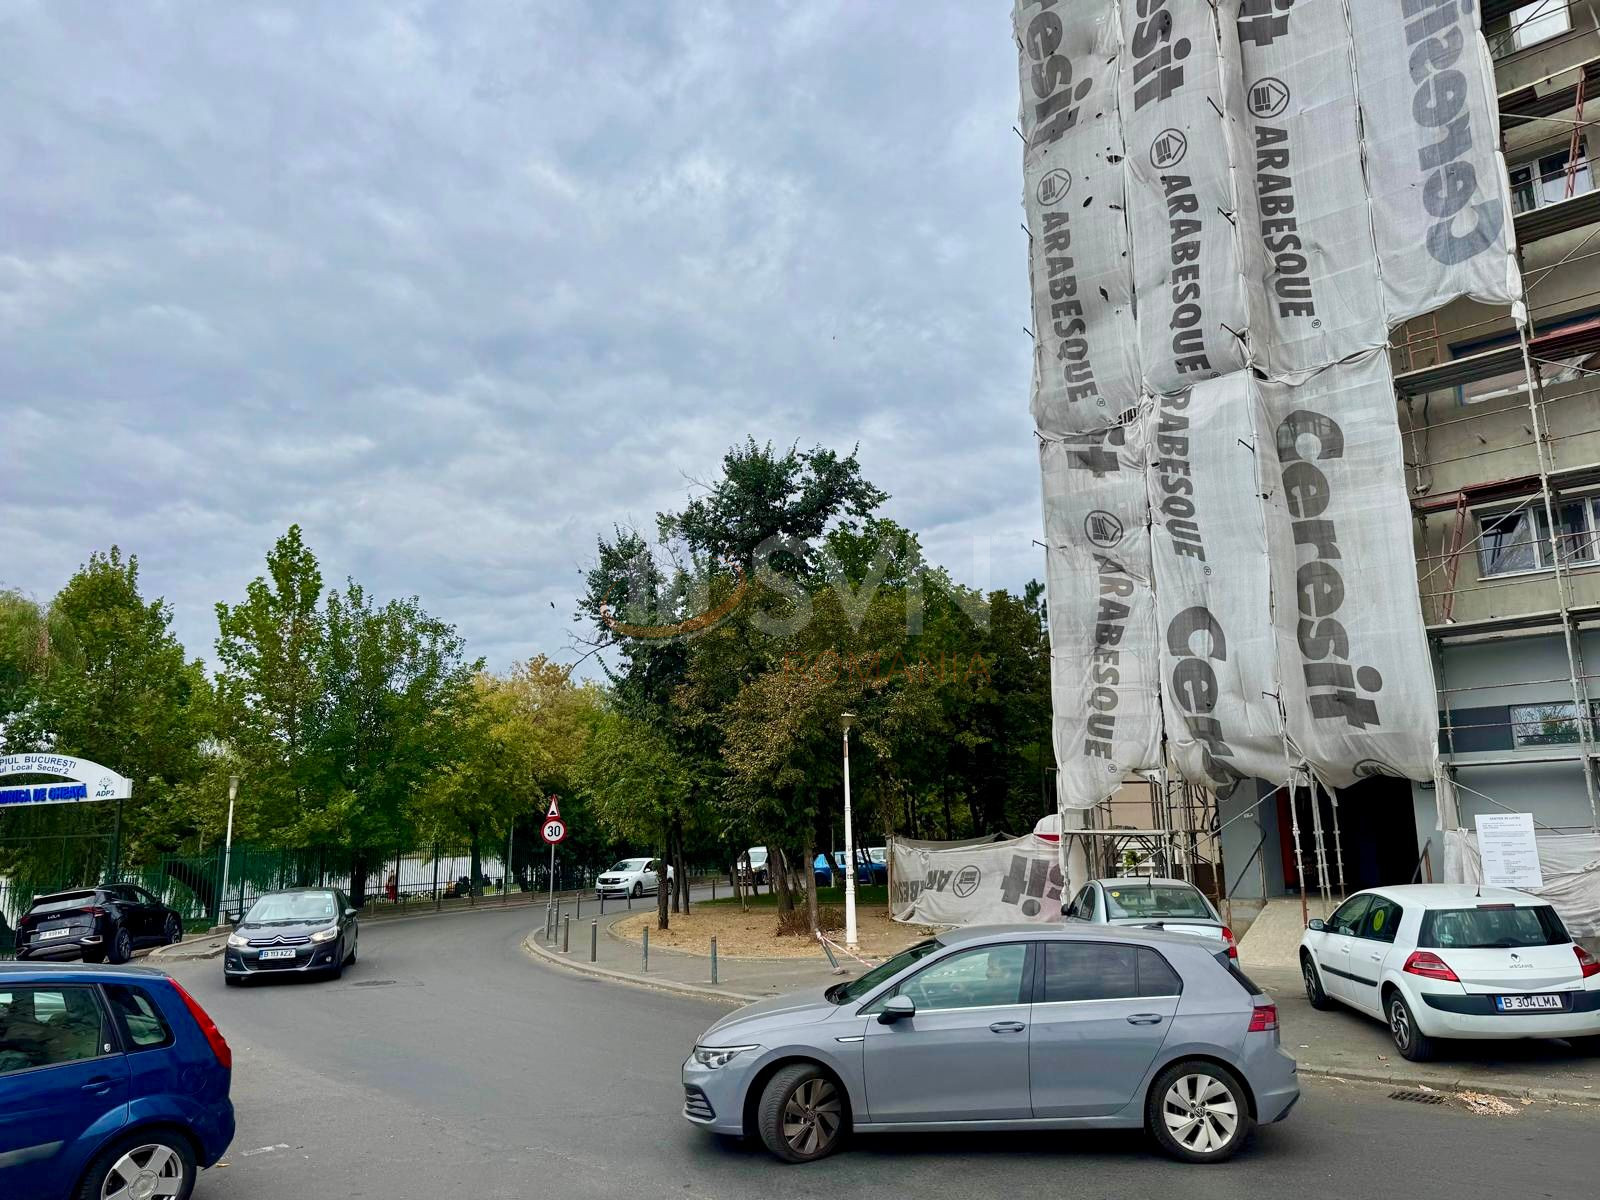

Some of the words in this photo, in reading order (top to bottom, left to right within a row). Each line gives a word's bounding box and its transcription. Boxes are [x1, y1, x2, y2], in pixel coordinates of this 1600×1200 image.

[1022, 0, 1093, 150] esit
[1042, 211, 1098, 403] ARABESQUE
[1161, 174, 1211, 375] ARABESQUE
[1255, 125, 1315, 319] ARABESQUE
[1276, 409, 1383, 731] Ceresit
[1083, 552, 1135, 760] ARABESQUE
[12, 764, 32, 772] Local
[37, 764, 62, 773] Sector
[33, 788, 47, 802] DE
[547, 825, 561, 837] 30
[1503, 997, 1512, 1008] B
[1517, 997, 1536, 1008] 304
[1537, 997, 1558, 1007] LMA
